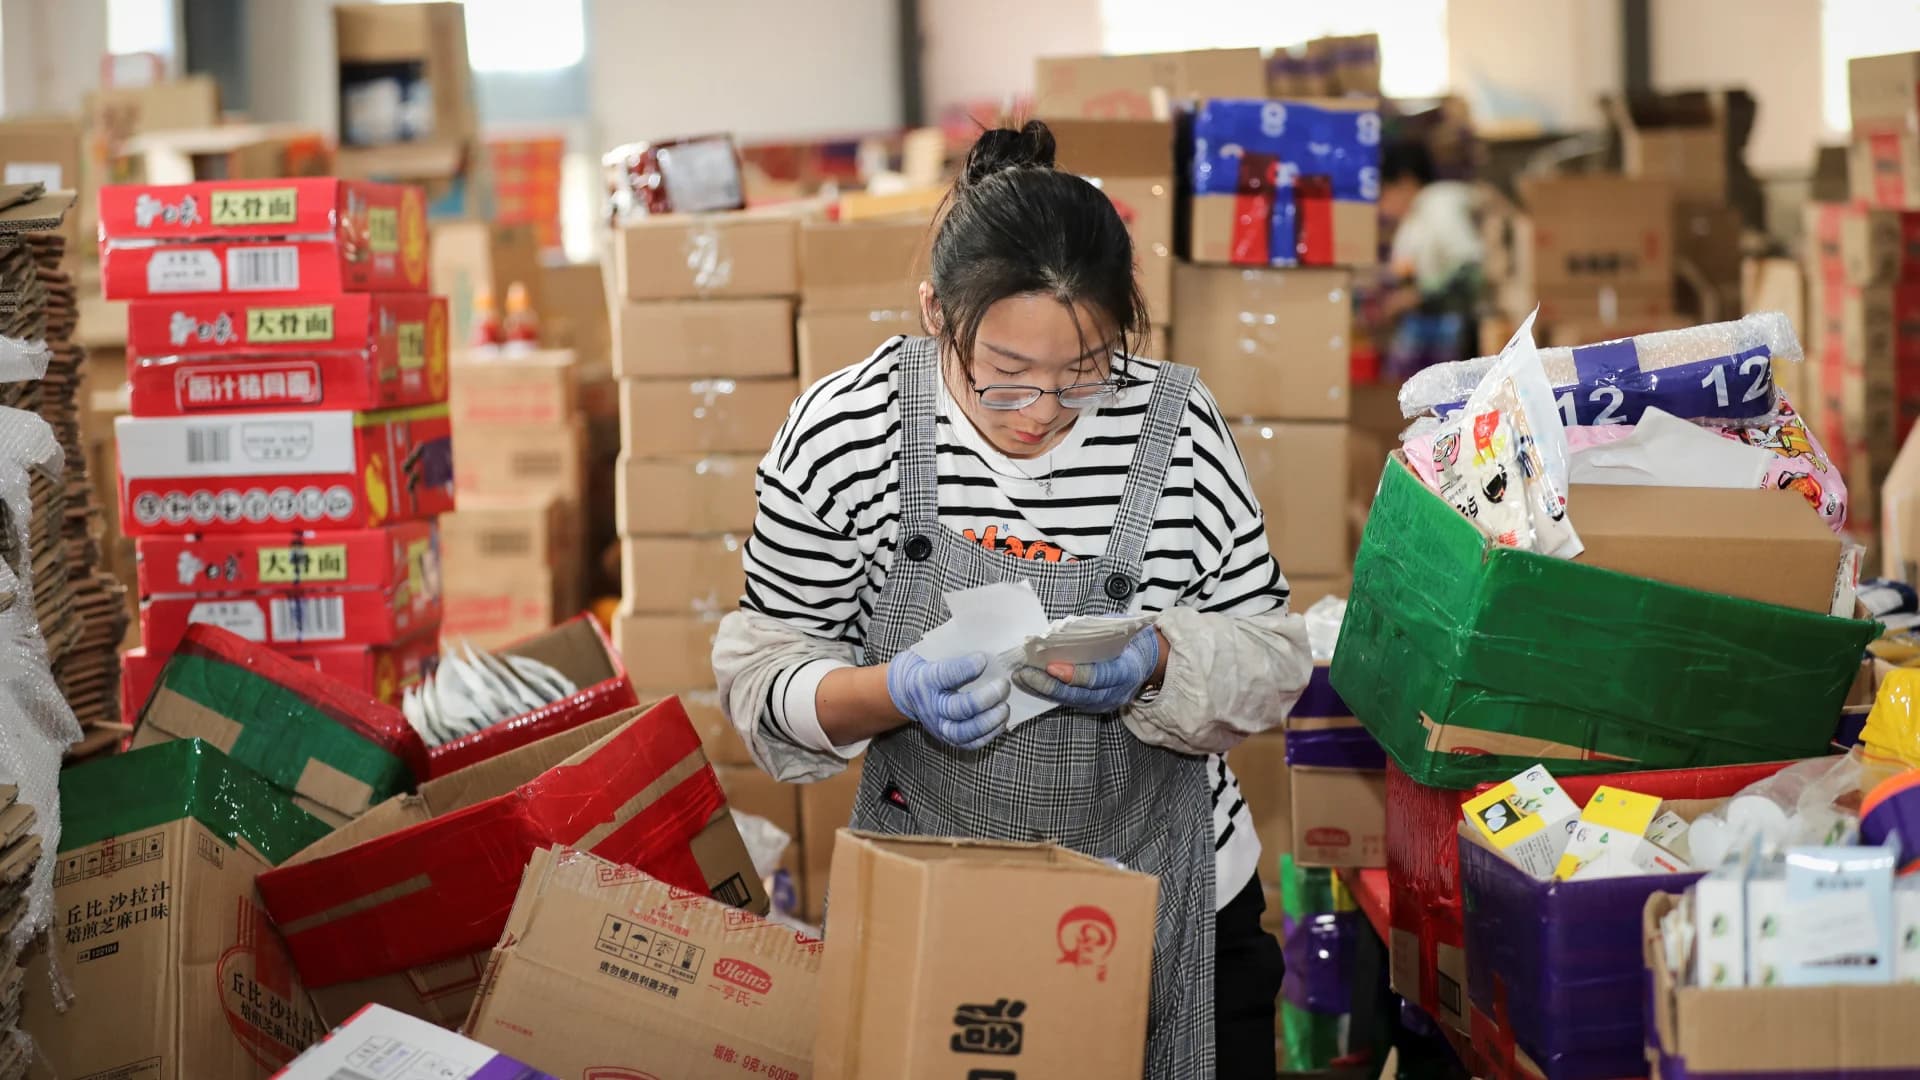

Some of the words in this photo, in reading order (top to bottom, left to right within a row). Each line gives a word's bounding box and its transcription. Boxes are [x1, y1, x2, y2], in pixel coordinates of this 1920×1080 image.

[1701, 354, 1770, 408] 12
[65, 903, 169, 945] 焙煎芝麻口味
[599, 960, 680, 999] 请勿使用利器开箱
[716, 960, 770, 992] Heinz
[950, 997, 1026, 1080] 调
